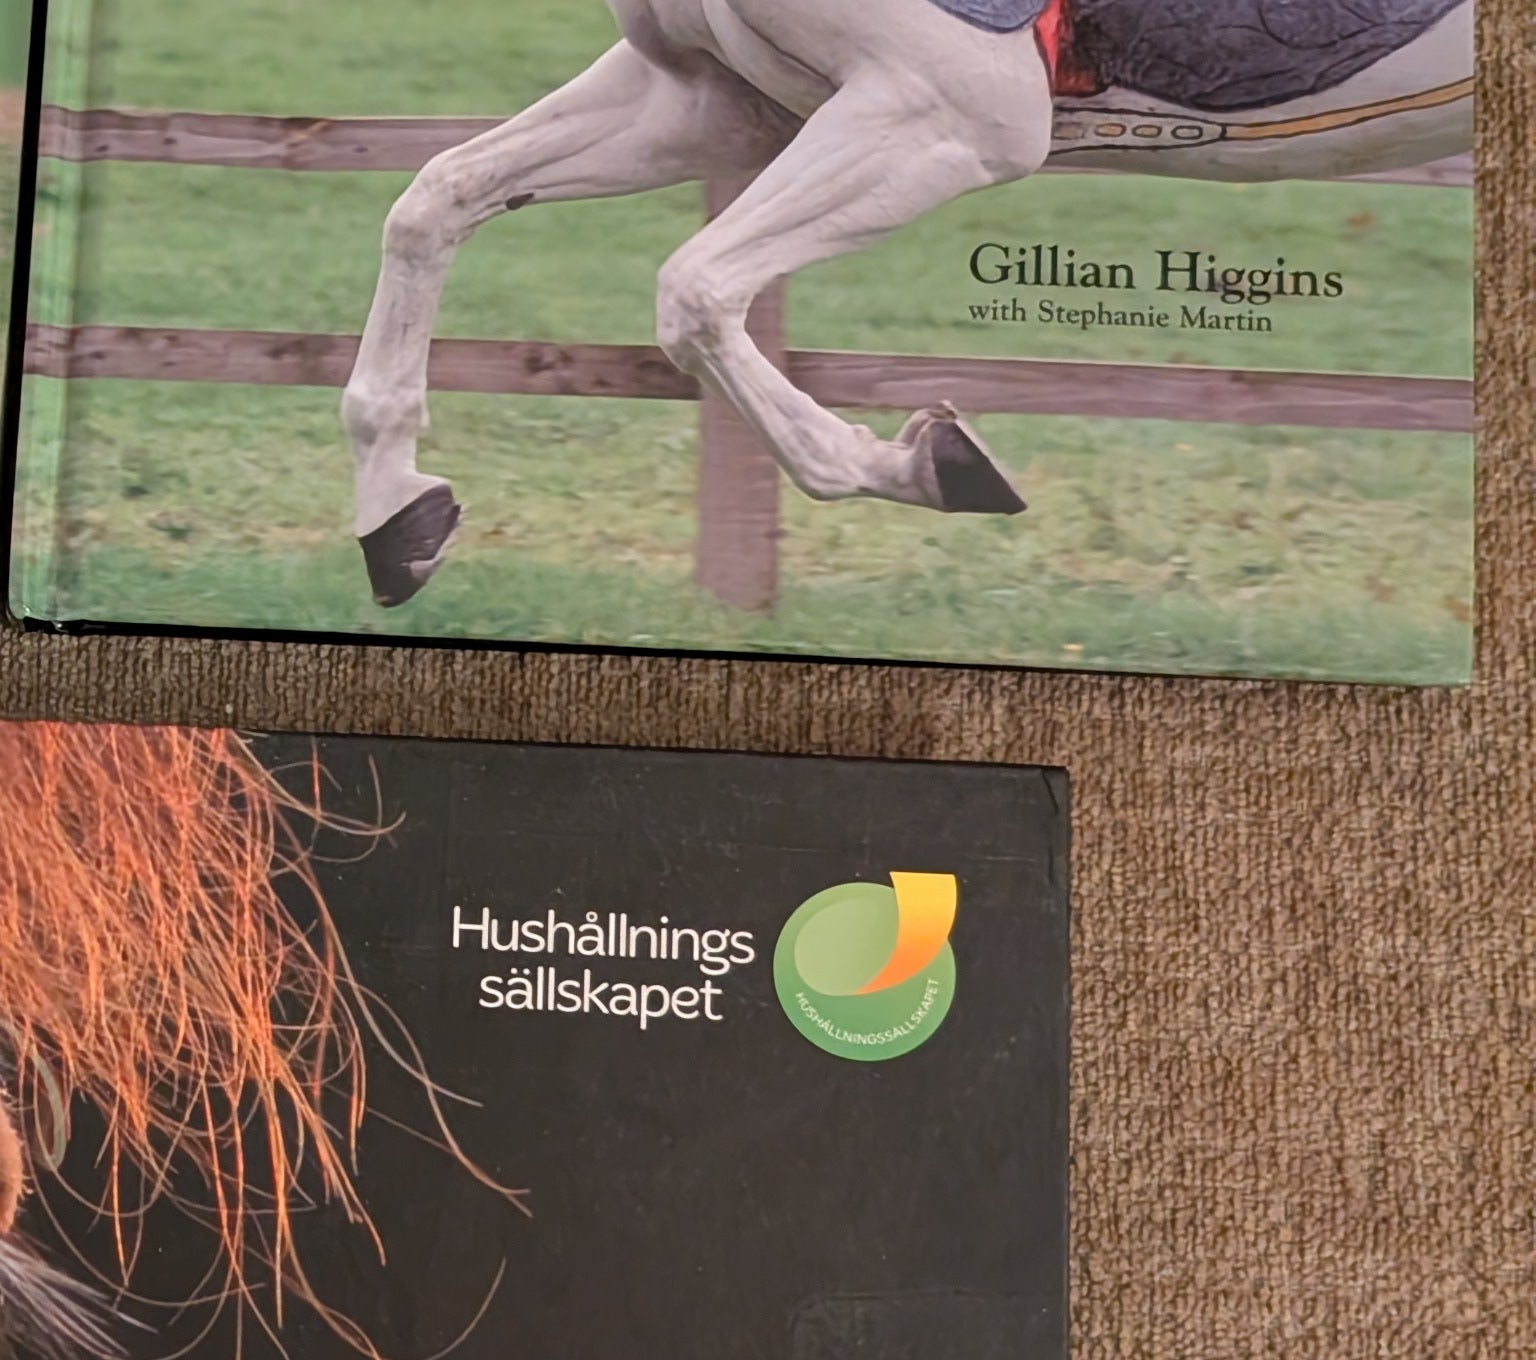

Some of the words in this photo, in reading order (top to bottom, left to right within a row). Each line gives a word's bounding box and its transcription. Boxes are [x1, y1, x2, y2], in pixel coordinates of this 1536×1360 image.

[969, 242, 1137, 290] Gillian
[1154, 249, 1345, 306] Higgins
[968, 299, 1027, 323] with
[1037, 299, 1170, 330] Stephanie
[1180, 305, 1273, 332] Martin
[452, 905, 755, 976] Hushållnings
[478, 965, 724, 1030] sällskapet
